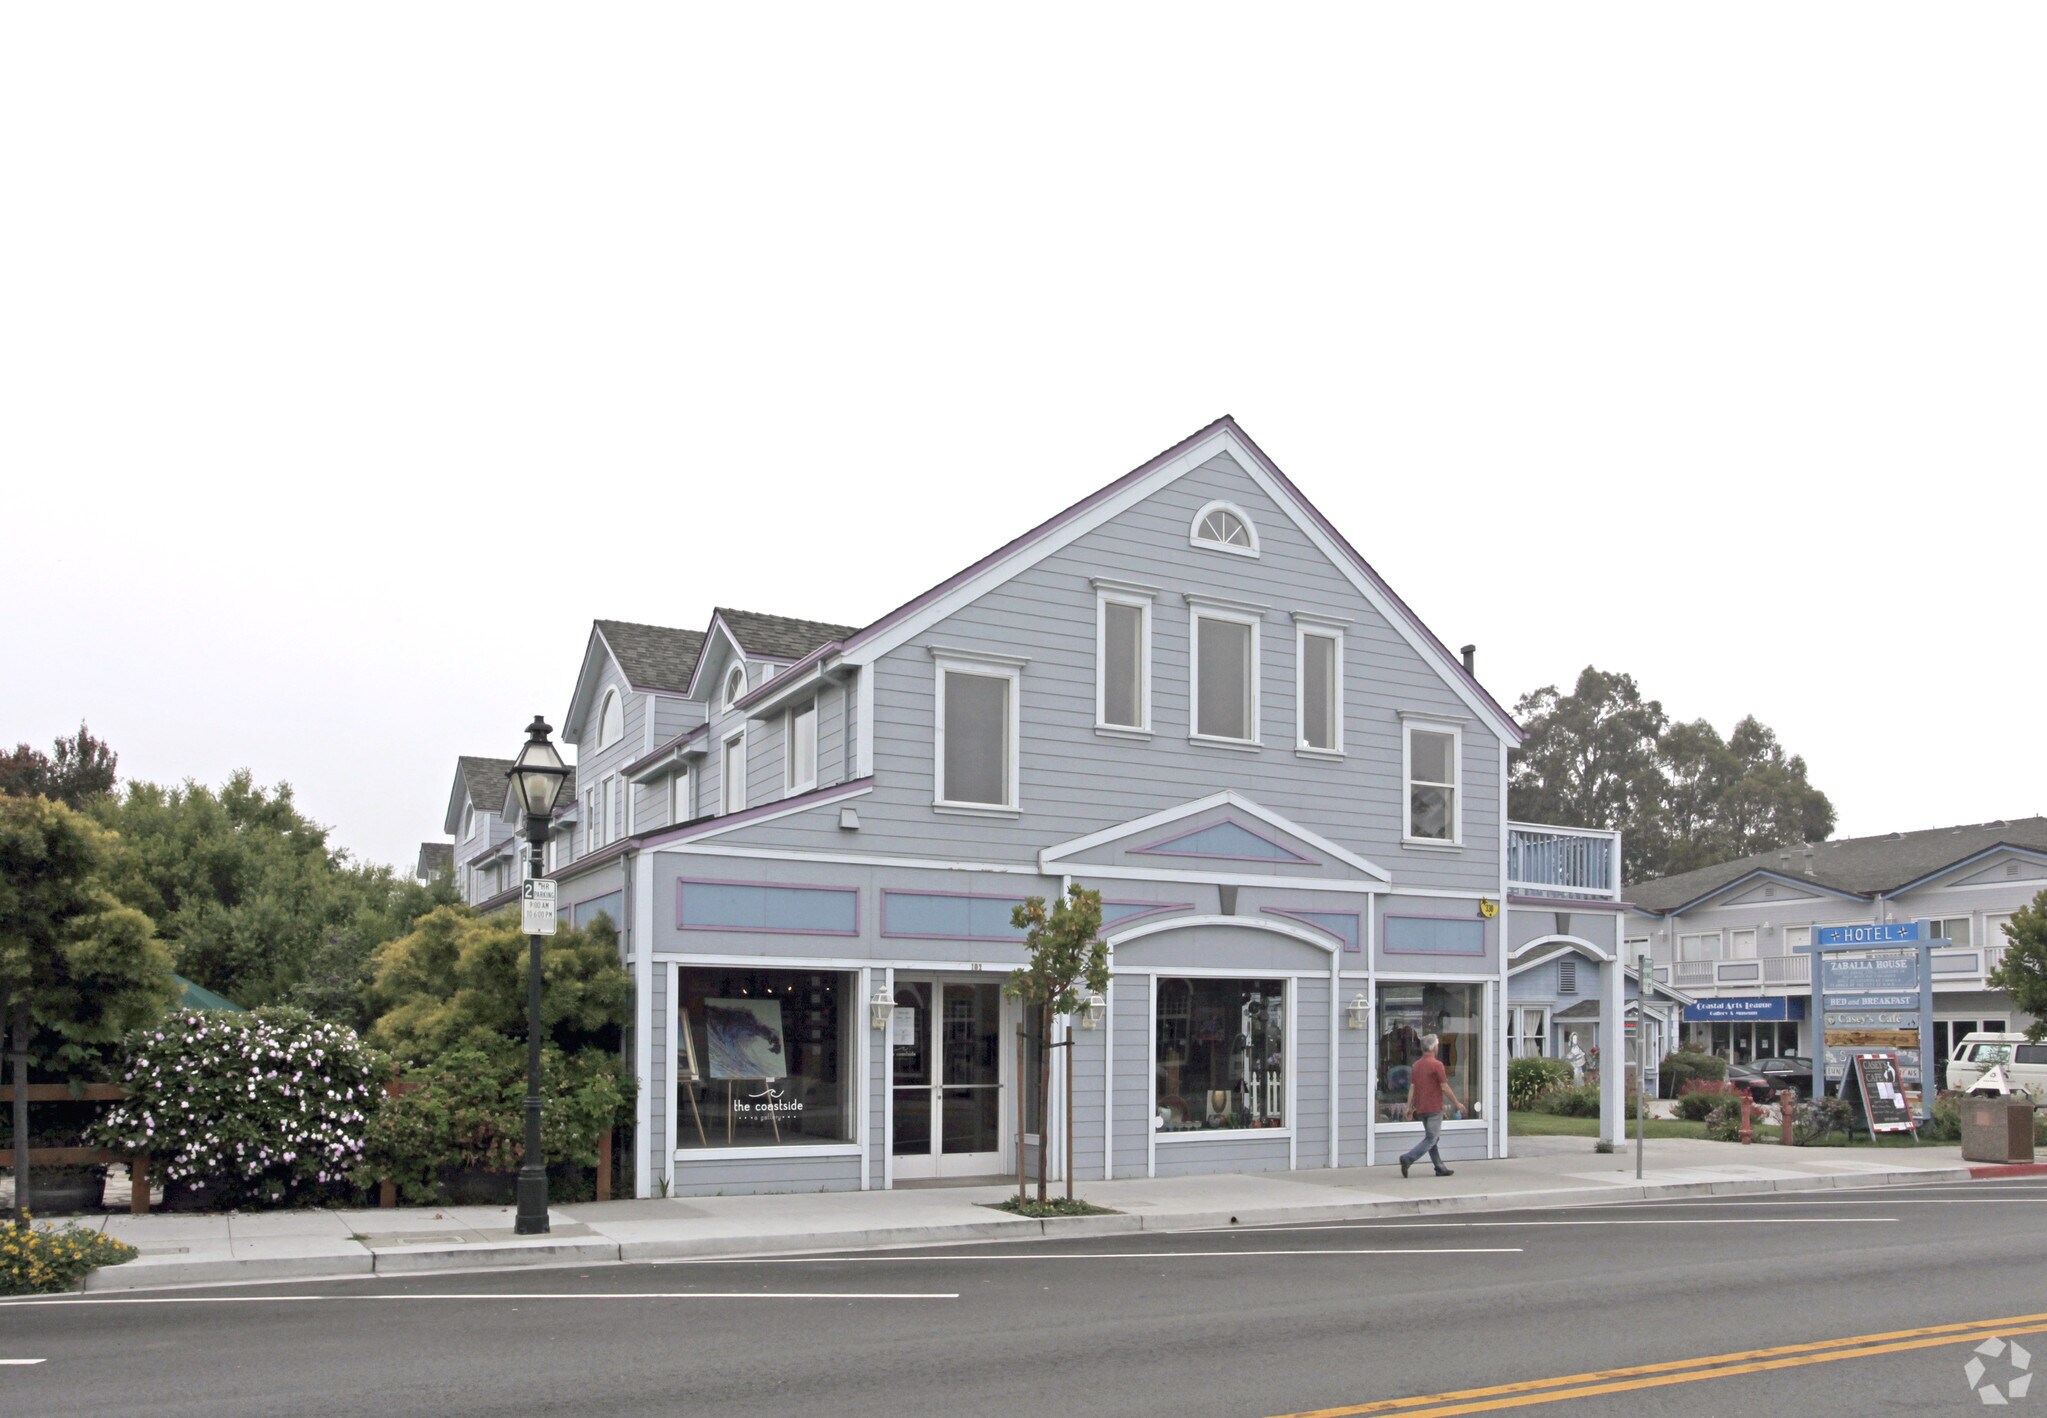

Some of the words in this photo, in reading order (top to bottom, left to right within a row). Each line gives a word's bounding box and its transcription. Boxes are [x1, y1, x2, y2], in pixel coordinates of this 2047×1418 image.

[525, 884, 533, 898] 2
[1844, 927, 1892, 942] HOTEL
[1830, 961, 1873, 970] ZABALLA
[1876, 960, 1907, 969] HOUSE
[1696, 1002, 1724, 1010] Coastal
[1725, 1002, 1742, 1010] Arts
[1745, 1002, 1772, 1010] League
[1830, 998, 1847, 1006] BED
[1862, 997, 1910, 1005] BREAKFAST
[1838, 1014, 1874, 1024] Casey's
[733, 1099, 750, 1111] the
[755, 1099, 803, 1111] coastside
